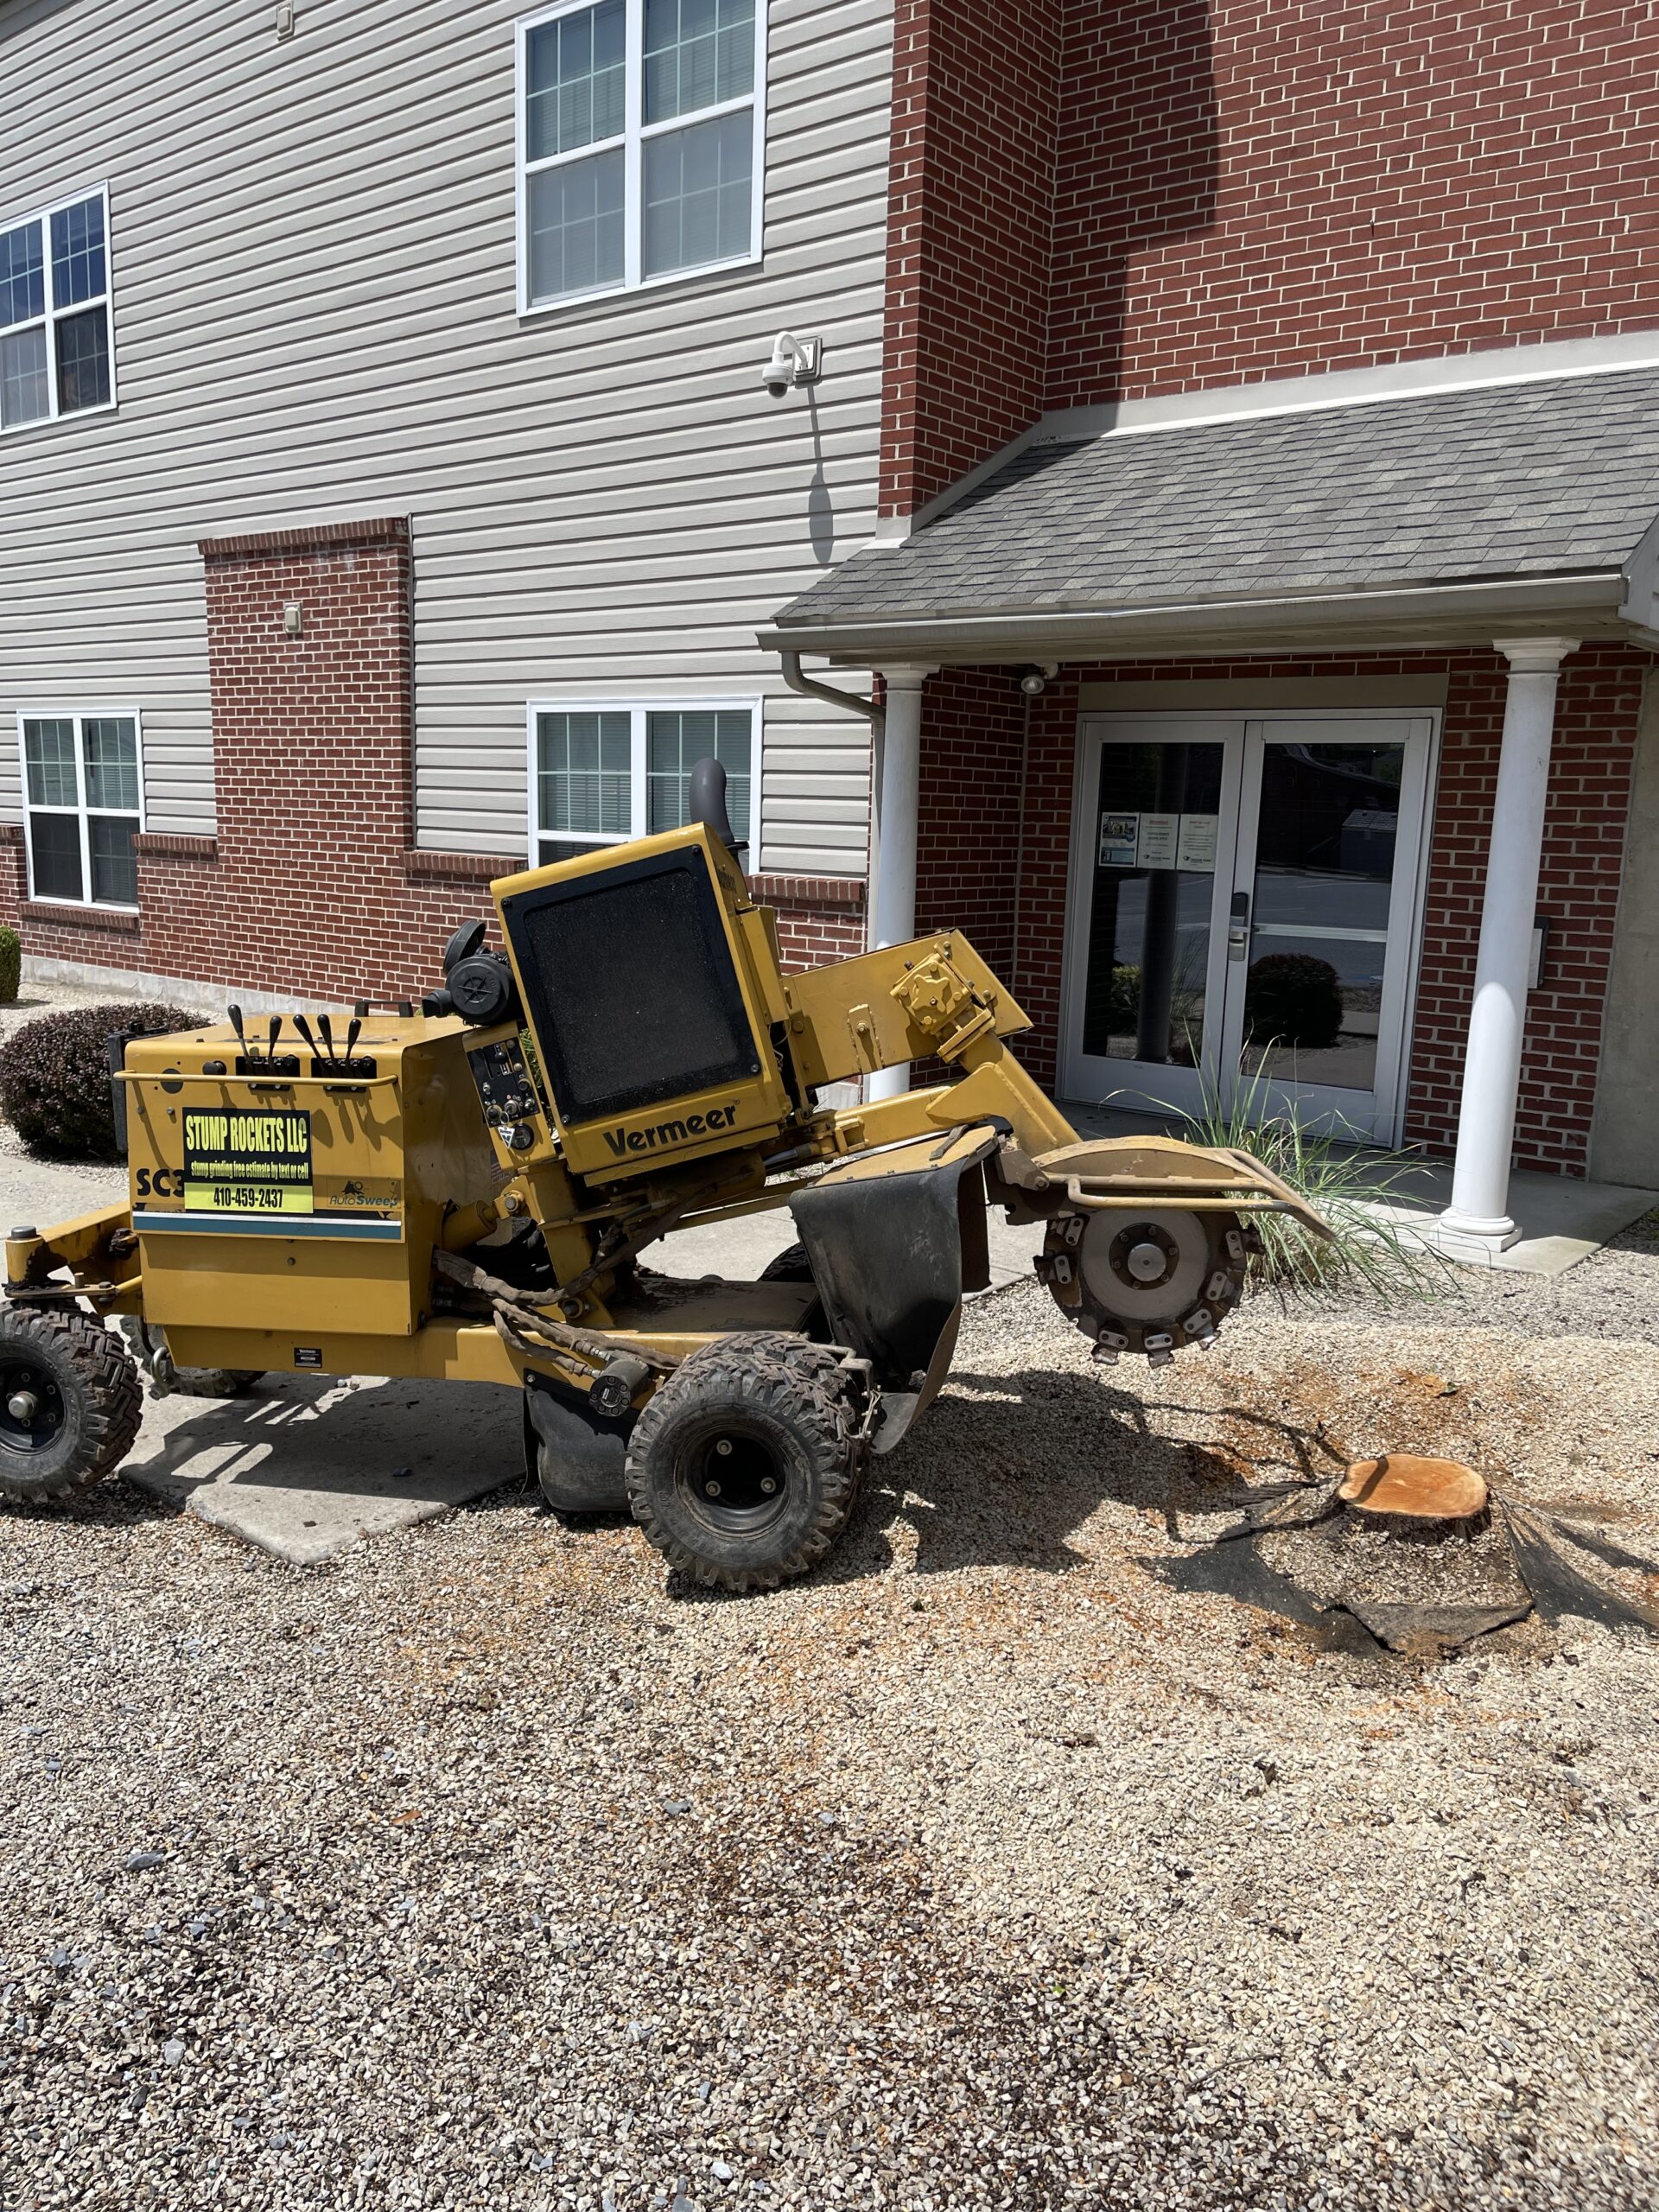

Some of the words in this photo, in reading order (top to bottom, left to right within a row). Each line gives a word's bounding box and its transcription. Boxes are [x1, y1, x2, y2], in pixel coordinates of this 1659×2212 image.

[186, 1115, 226, 1150] STUMP
[230, 1116, 284, 1153] ROCKETS
[287, 1118, 307, 1153] LLC
[602, 1105, 736, 1156] Vermeer
[191, 1160, 208, 1178] stump
[209, 1160, 233, 1179] grinding
[233, 1160, 245, 1178] free
[245, 1161, 270, 1179] estimate
[270, 1161, 277, 1180] by
[278, 1163, 290, 1179] text
[290, 1165, 297, 1179] or
[213, 1187, 283, 1208] 410-459-2437
[329, 1195, 398, 1208] AutoSweep
